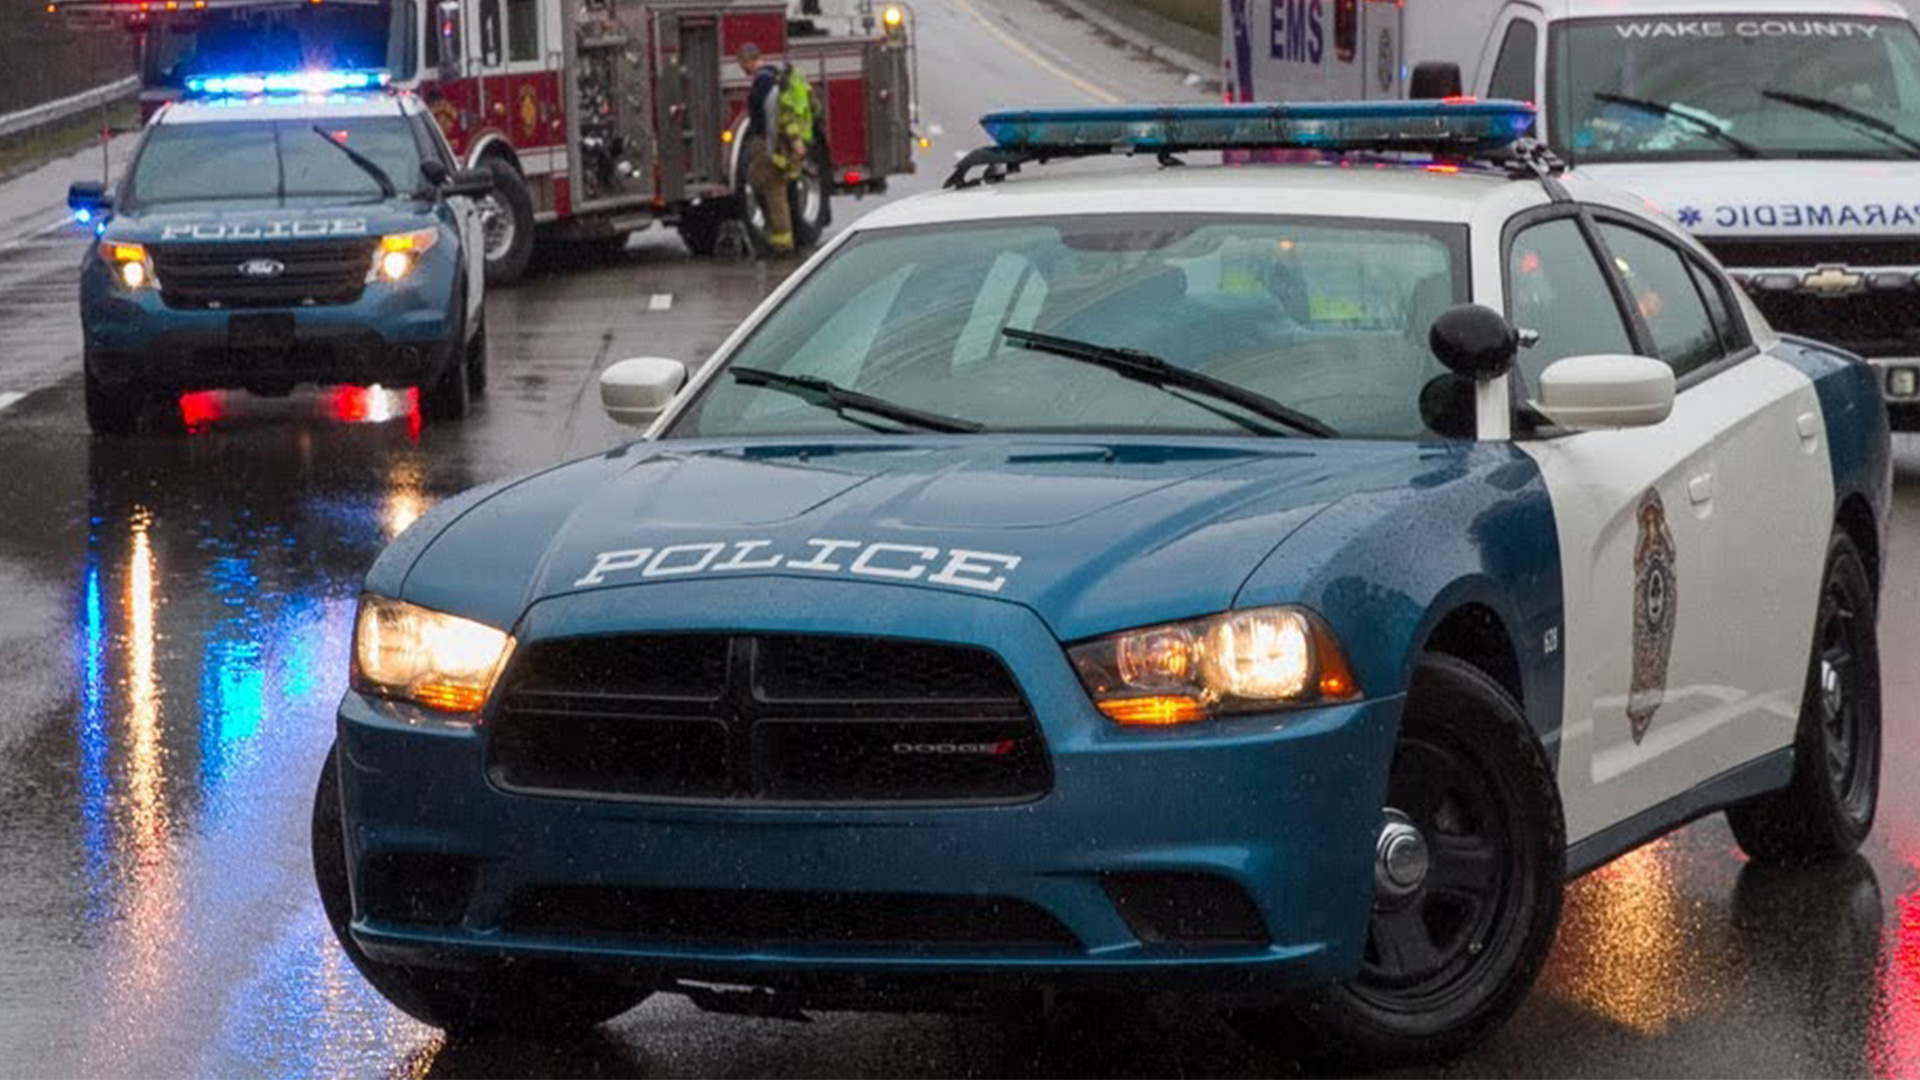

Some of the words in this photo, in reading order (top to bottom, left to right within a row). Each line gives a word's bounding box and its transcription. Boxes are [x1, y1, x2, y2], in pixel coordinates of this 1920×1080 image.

[1270, 0, 1324, 64] EMS
[1615, 21, 1724, 38] WAKE
[1736, 21, 1878, 38] COUNTY
[160, 218, 367, 239] POLICE
[574, 538, 1021, 592] POLICE
